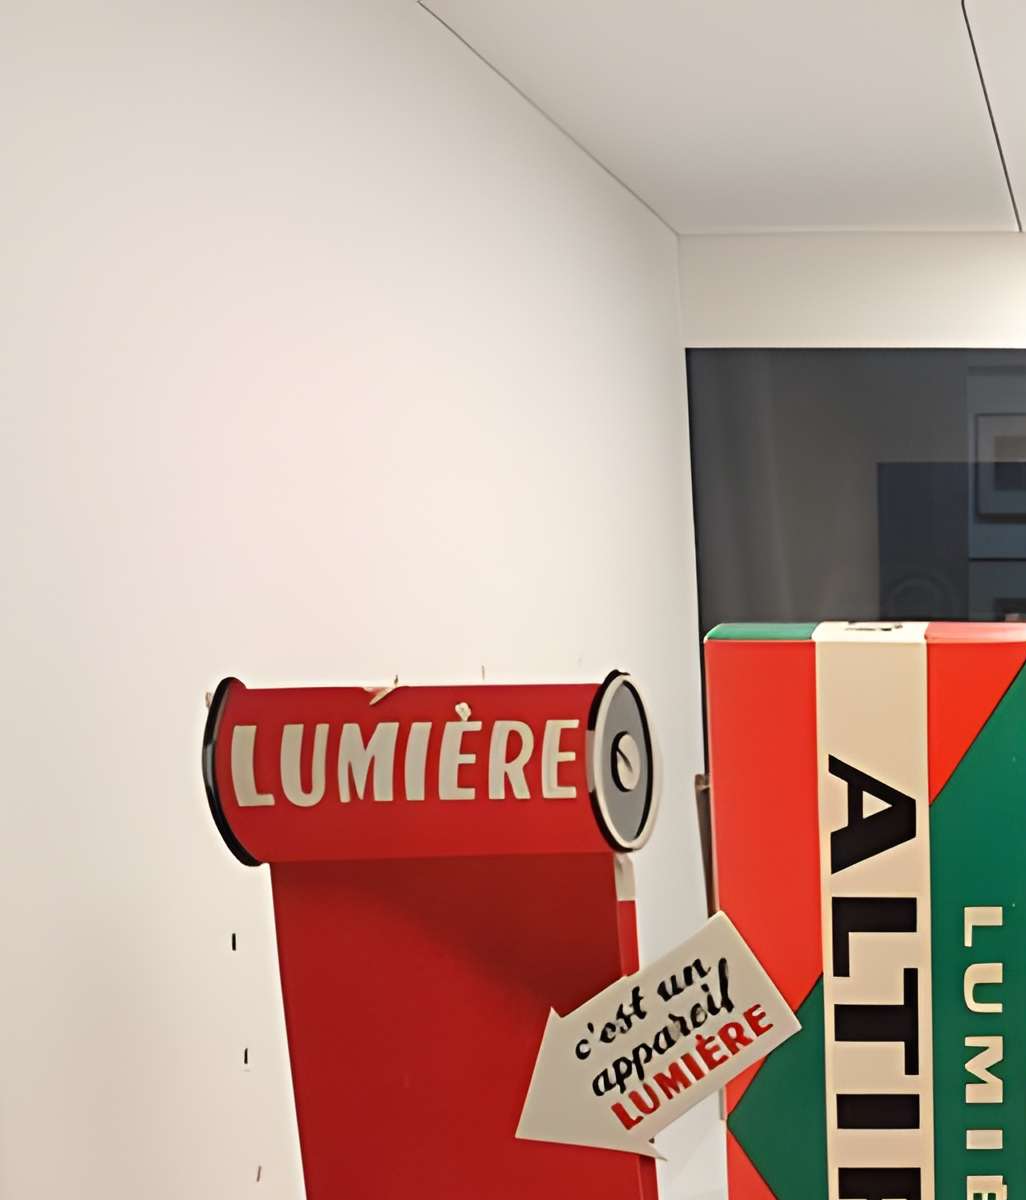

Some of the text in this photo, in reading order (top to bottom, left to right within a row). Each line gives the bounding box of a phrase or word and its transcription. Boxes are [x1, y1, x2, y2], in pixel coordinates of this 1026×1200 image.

[230, 702, 580, 808] LUMIÈRE
[657, 958, 712, 1002] un
[610, 1003, 774, 1131] LUMIÈRE
